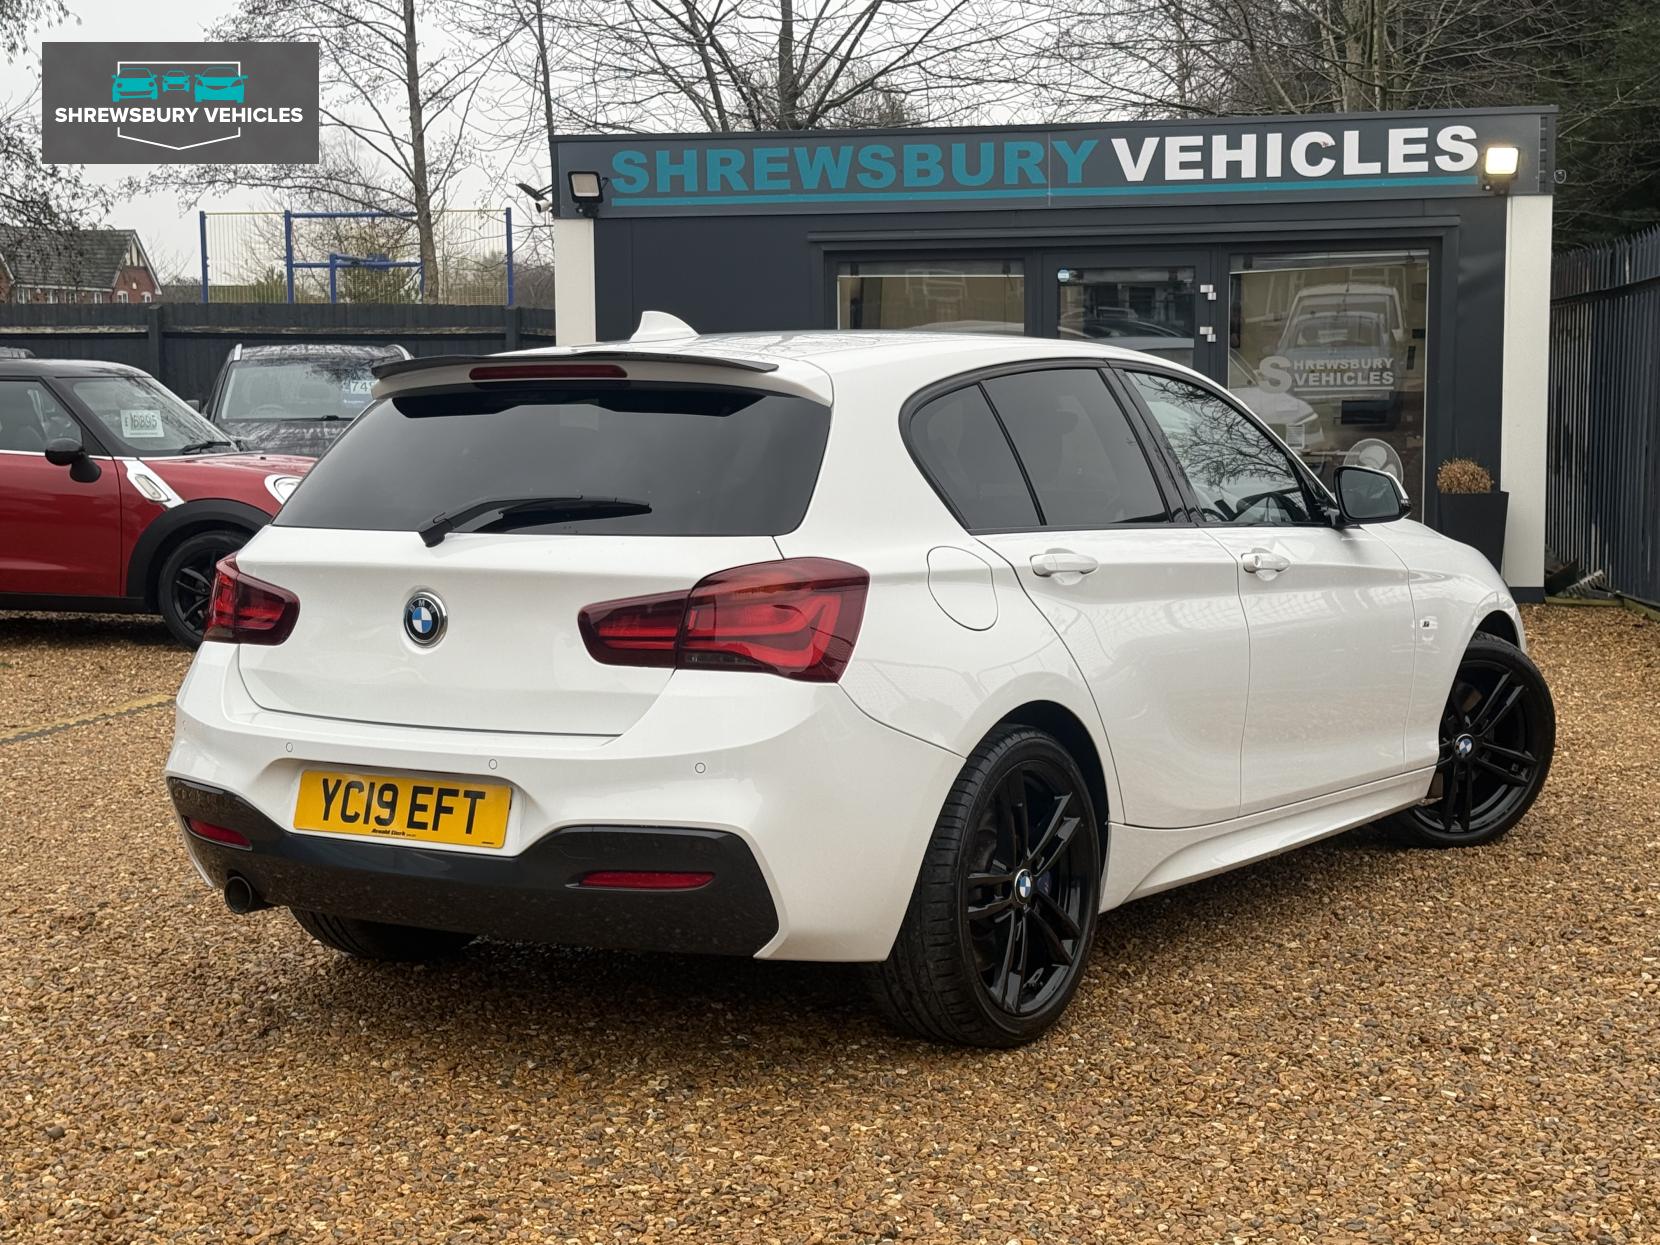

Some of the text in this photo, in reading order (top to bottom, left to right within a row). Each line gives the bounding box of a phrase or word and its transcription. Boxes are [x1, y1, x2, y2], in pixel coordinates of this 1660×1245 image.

[610, 124, 1479, 194] SHREWSBURY VEHICLES
[1259, 355, 1395, 394] SHREWSBURY
[1294, 371, 1395, 387] VEHICLES
[321, 777, 487, 836] YC19 EFT
